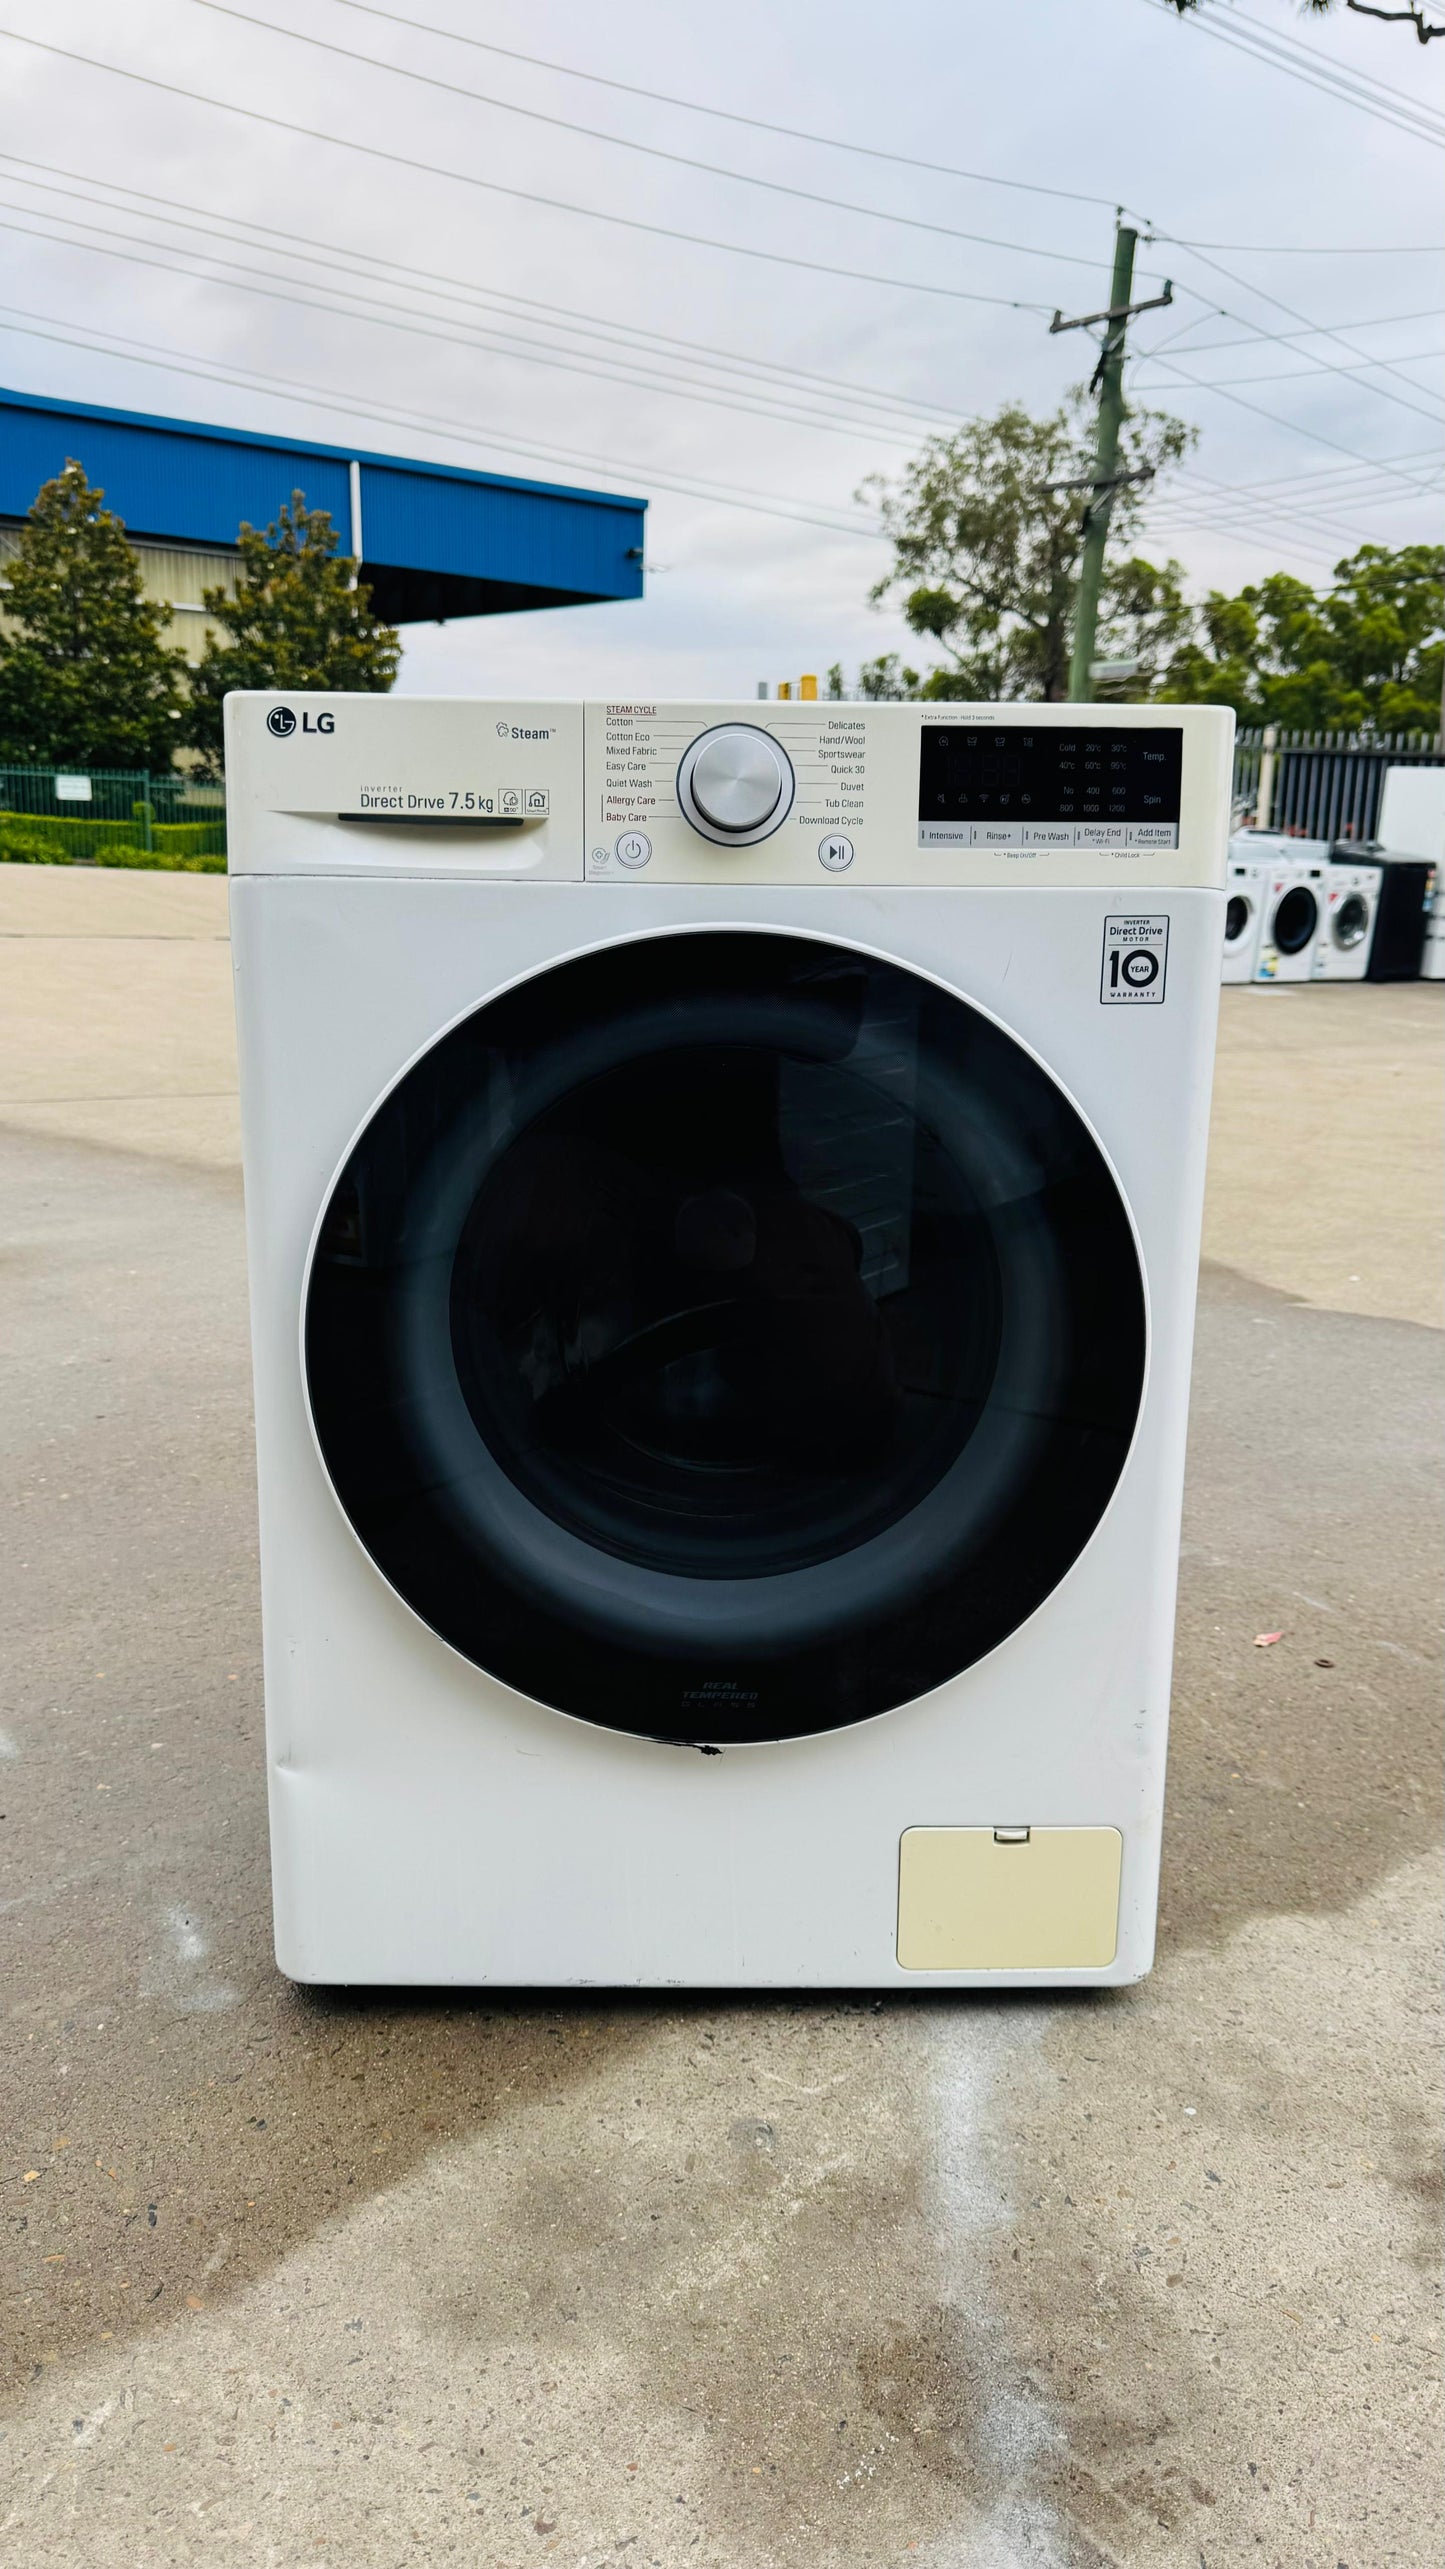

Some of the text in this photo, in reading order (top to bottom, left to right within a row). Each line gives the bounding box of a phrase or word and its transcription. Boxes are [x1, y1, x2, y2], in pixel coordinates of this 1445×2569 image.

[606, 705, 657, 714] STEAM CYCLE
[303, 713, 335, 734] LG
[606, 717, 633, 726] Cotton
[828, 721, 865, 730] Delicates
[606, 732, 650, 741] Cotton Eco
[819, 736, 865, 745] Hand/Wool
[606, 746, 657, 756] Mixed Fabric
[1059, 744, 1076, 752] Cold
[818, 750, 866, 760] Sportswear
[1143, 751, 1167, 762] Temp.
[606, 762, 646, 772] Easy Care
[831, 765, 865, 774] Quick 30
[606, 779, 652, 788] Quiet Wash
[841, 782, 864, 791] Duvet
[360, 785, 403, 793] inverter
[1064, 786, 1126, 795] No 400 600
[360, 793, 493, 813] Direct Drive 7.5 kg
[606, 796, 656, 807] Allergy Care
[825, 799, 864, 808] Tub Clean
[1143, 795, 1161, 805] Spin
[1059, 804, 1125, 812] 800 1000 1200
[606, 813, 647, 823] Baby Care
[799, 816, 863, 826] Download Cycle
[929, 832, 963, 840] Intensive
[1033, 832, 1069, 840] Pre Wash
[1084, 828, 1121, 837] Delay End
[1138, 829, 1171, 837] Add Item
[1110, 926, 1163, 935] Direct Drive
[1109, 949, 1159, 988] 10
[702, 1682, 738, 1690] REAL
[683, 1691, 758, 1700] TEMPERED
